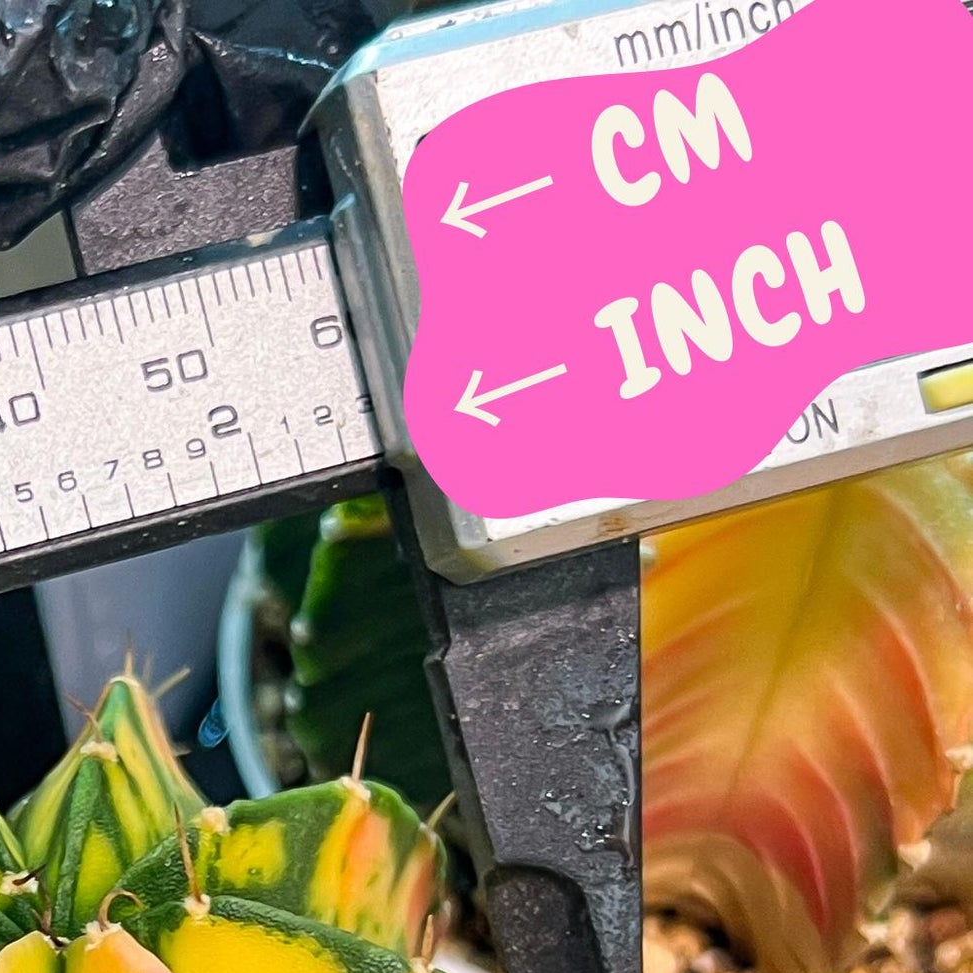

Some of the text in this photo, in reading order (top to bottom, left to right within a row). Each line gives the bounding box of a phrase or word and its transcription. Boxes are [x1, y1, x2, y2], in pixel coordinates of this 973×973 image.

[614, 0, 794, 67] mm/inch
[141, 350, 208, 392] 50
[310, 315, 343, 349] 6
[13, 481, 34, 504] 5
[57, 470, 78, 493] 6
[103, 458, 119, 480] 7
[141, 448, 164, 471] 8
[185, 437, 207, 460] 9
[207, 404, 242, 440] 2
[280, 415, 291, 434] 1
[312, 404, 334, 427] 2
